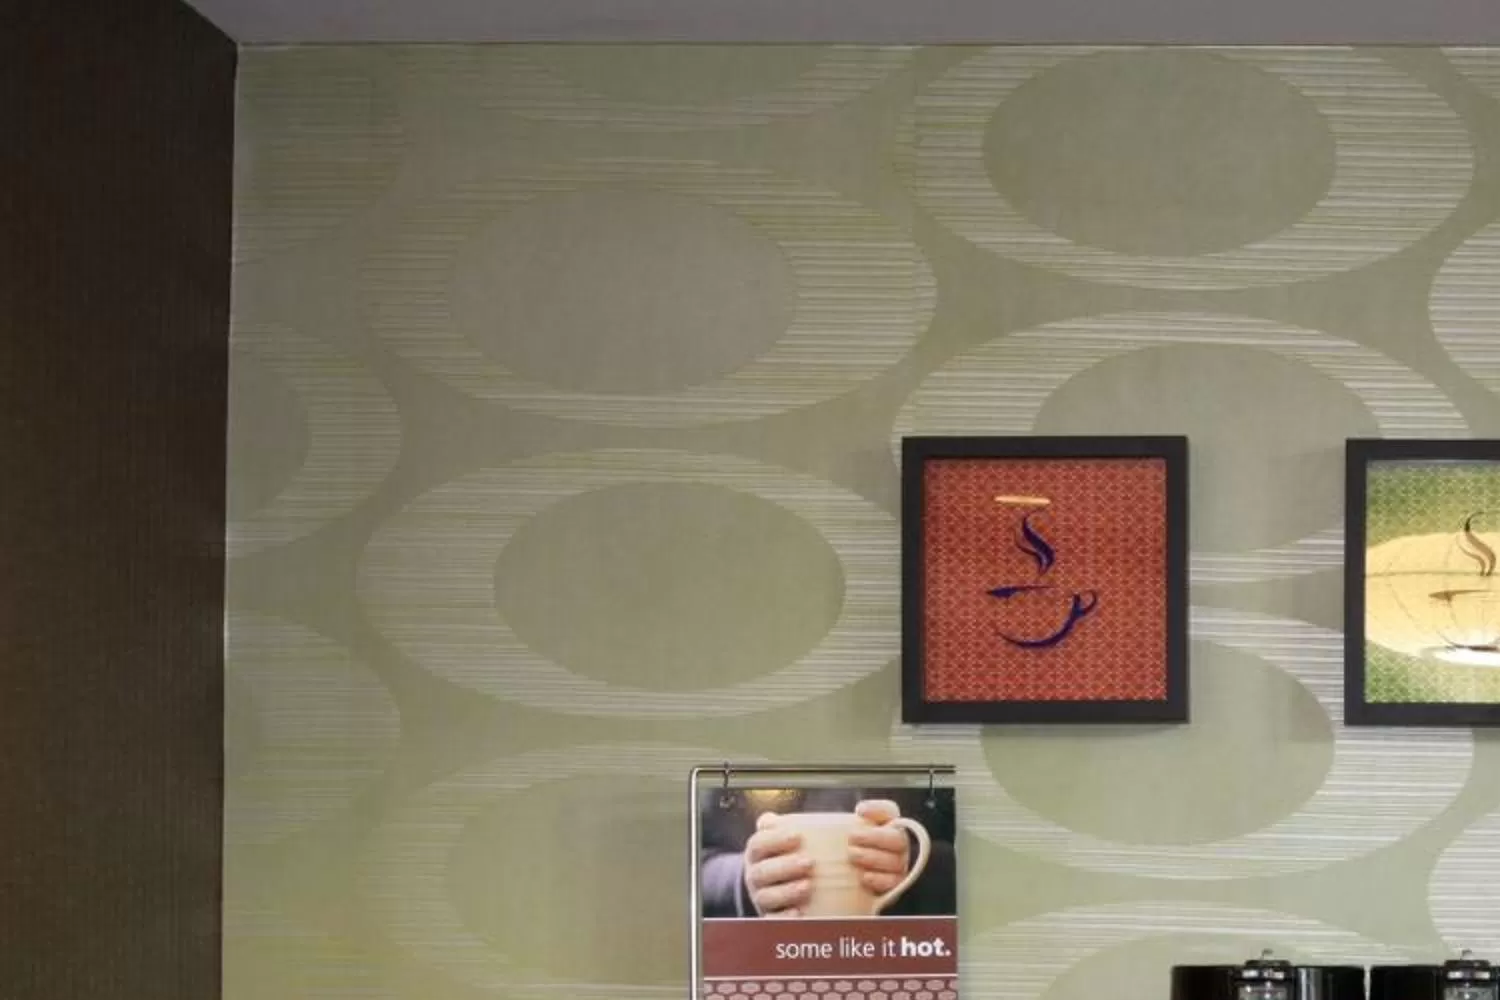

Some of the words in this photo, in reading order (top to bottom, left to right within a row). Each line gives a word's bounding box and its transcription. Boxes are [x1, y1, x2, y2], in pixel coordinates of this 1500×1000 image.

[775, 941, 833, 959] some
[838, 936, 875, 958] like
[881, 936, 897, 957] it
[900, 936, 952, 957] hot.
